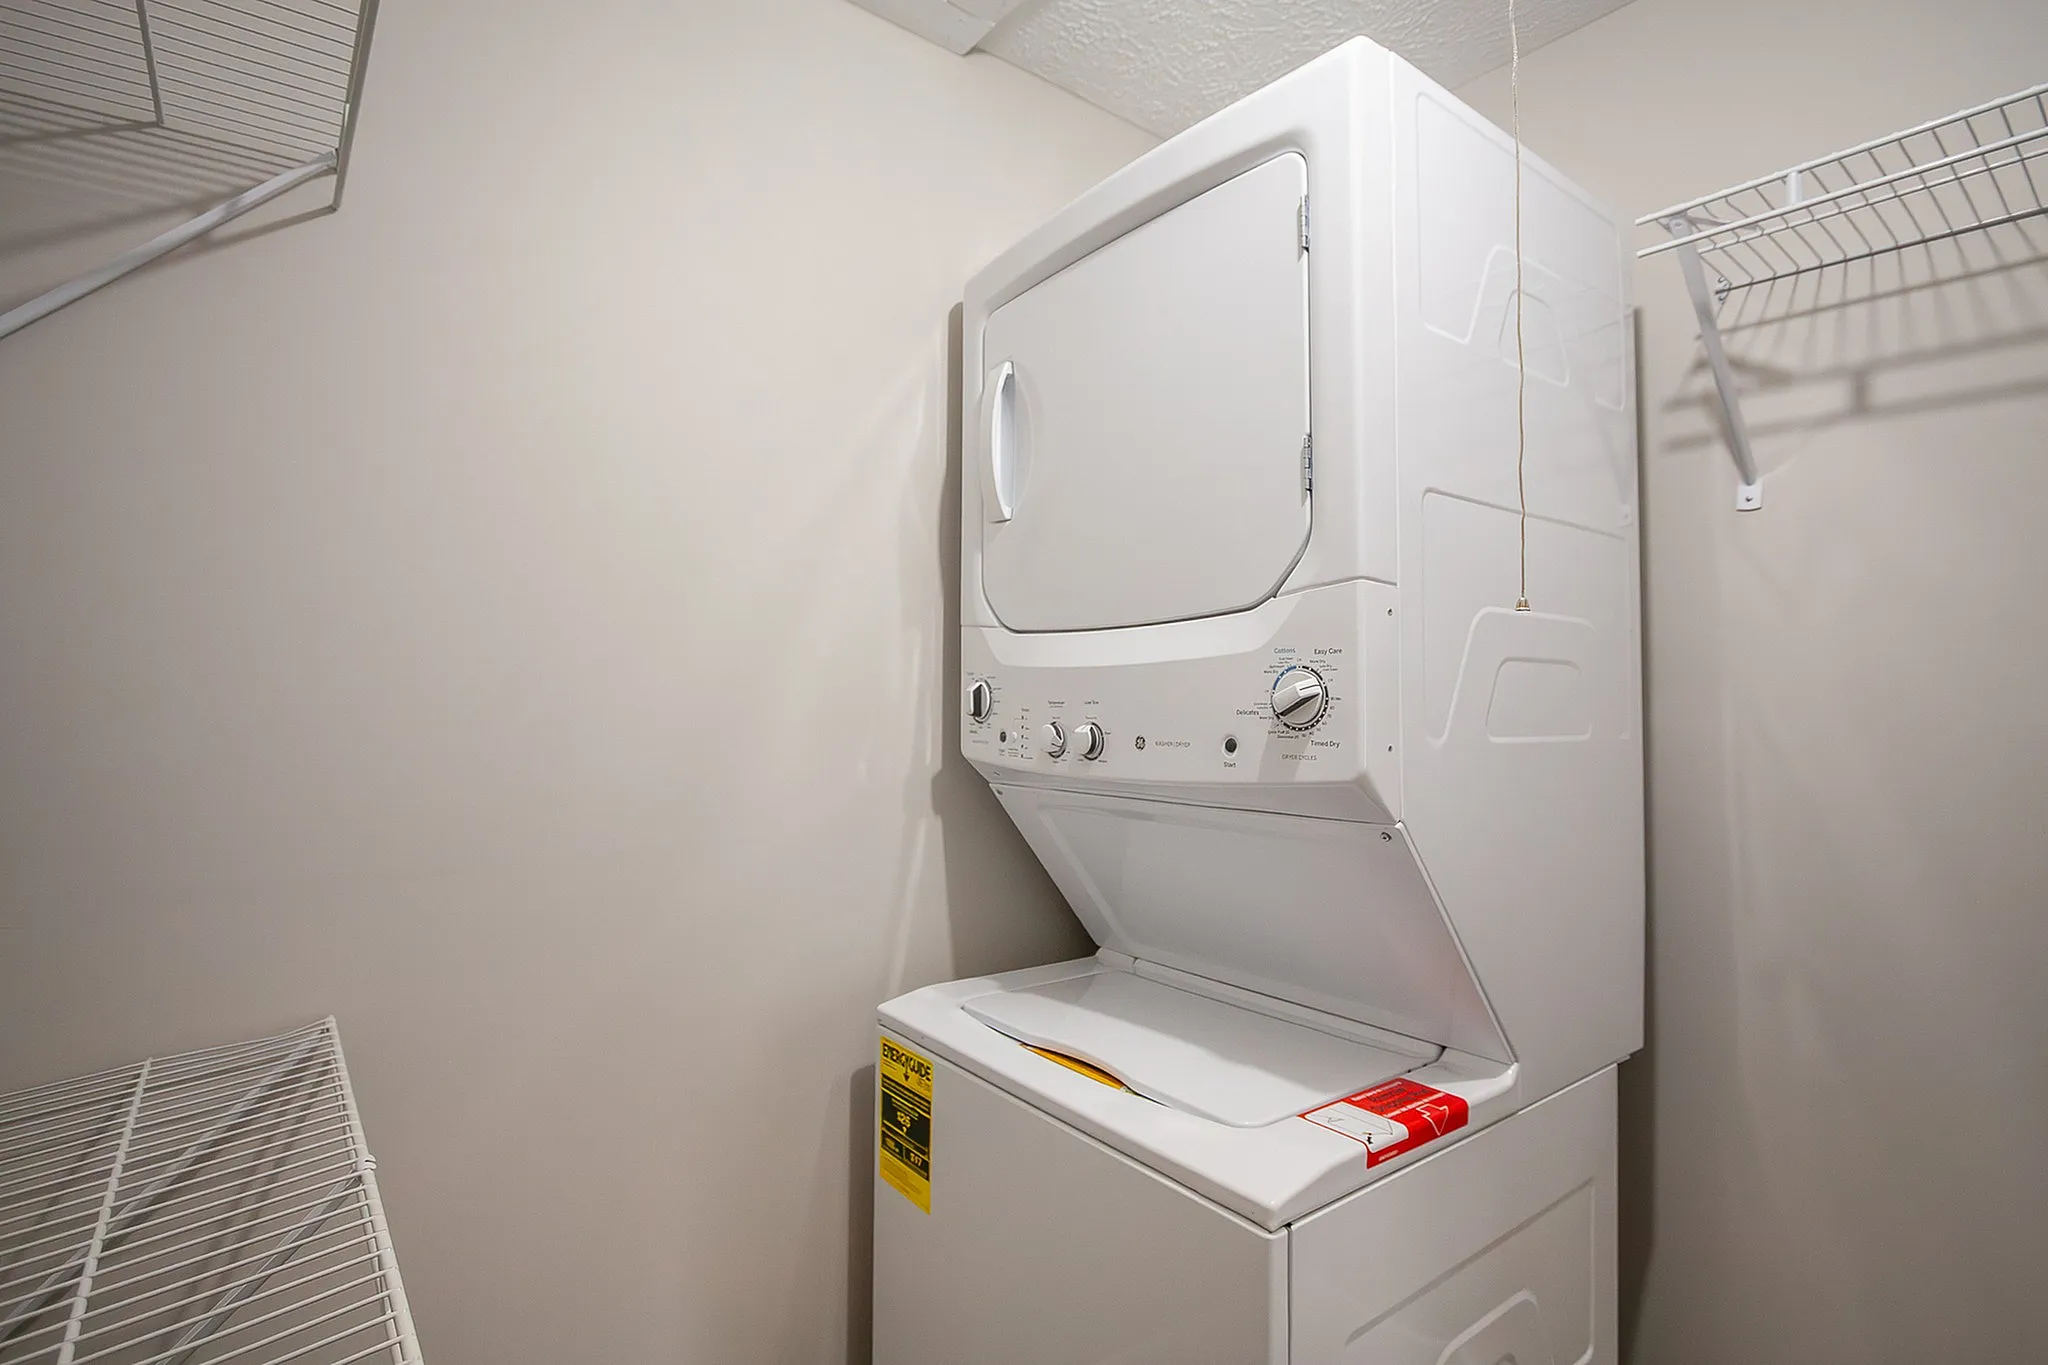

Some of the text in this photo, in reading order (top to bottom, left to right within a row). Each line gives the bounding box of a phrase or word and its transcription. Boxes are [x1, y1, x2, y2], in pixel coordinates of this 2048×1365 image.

[1314, 647, 1343, 656] Easy Care
[1310, 739, 1341, 749] Timed Dry
